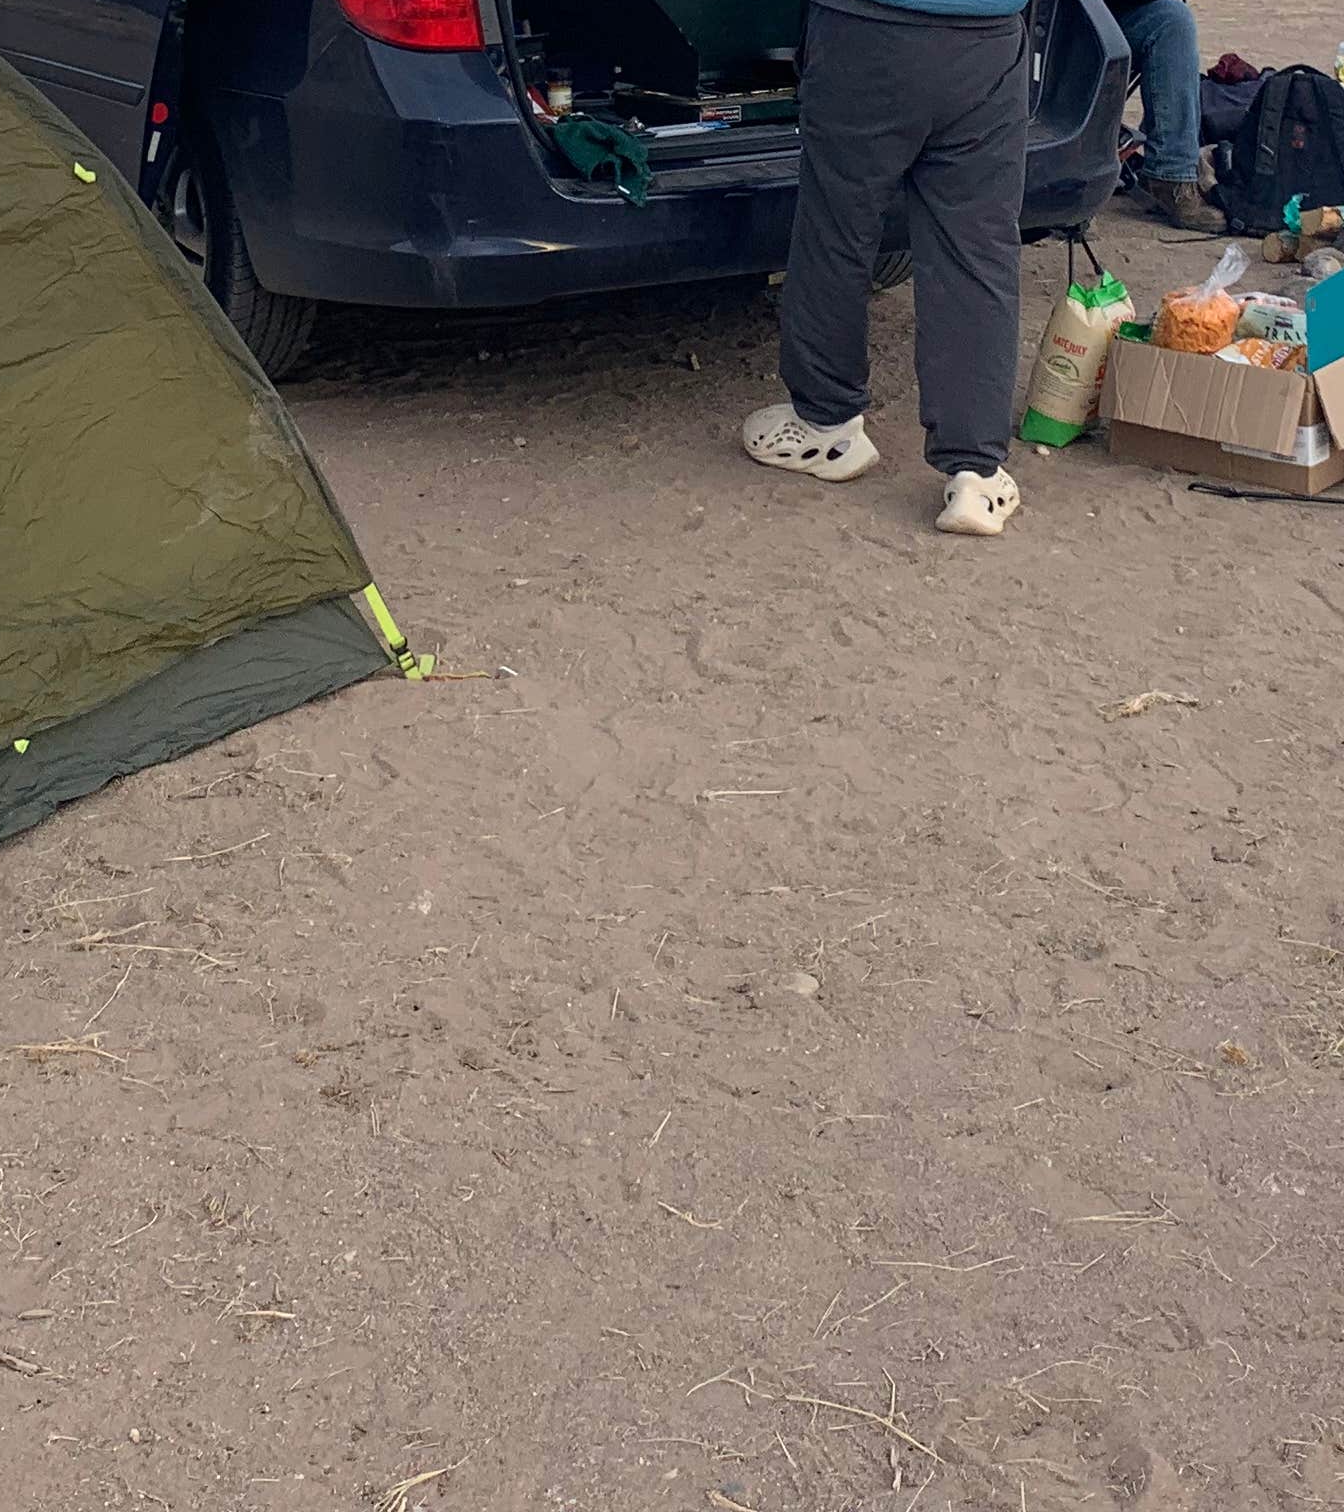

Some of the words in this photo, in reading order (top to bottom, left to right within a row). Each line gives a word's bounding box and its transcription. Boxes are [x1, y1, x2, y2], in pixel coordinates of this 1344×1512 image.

[1264, 326, 1308, 342] TRAI
[1052, 334, 1069, 349] LATE
[1065, 342, 1088, 357] JULY
